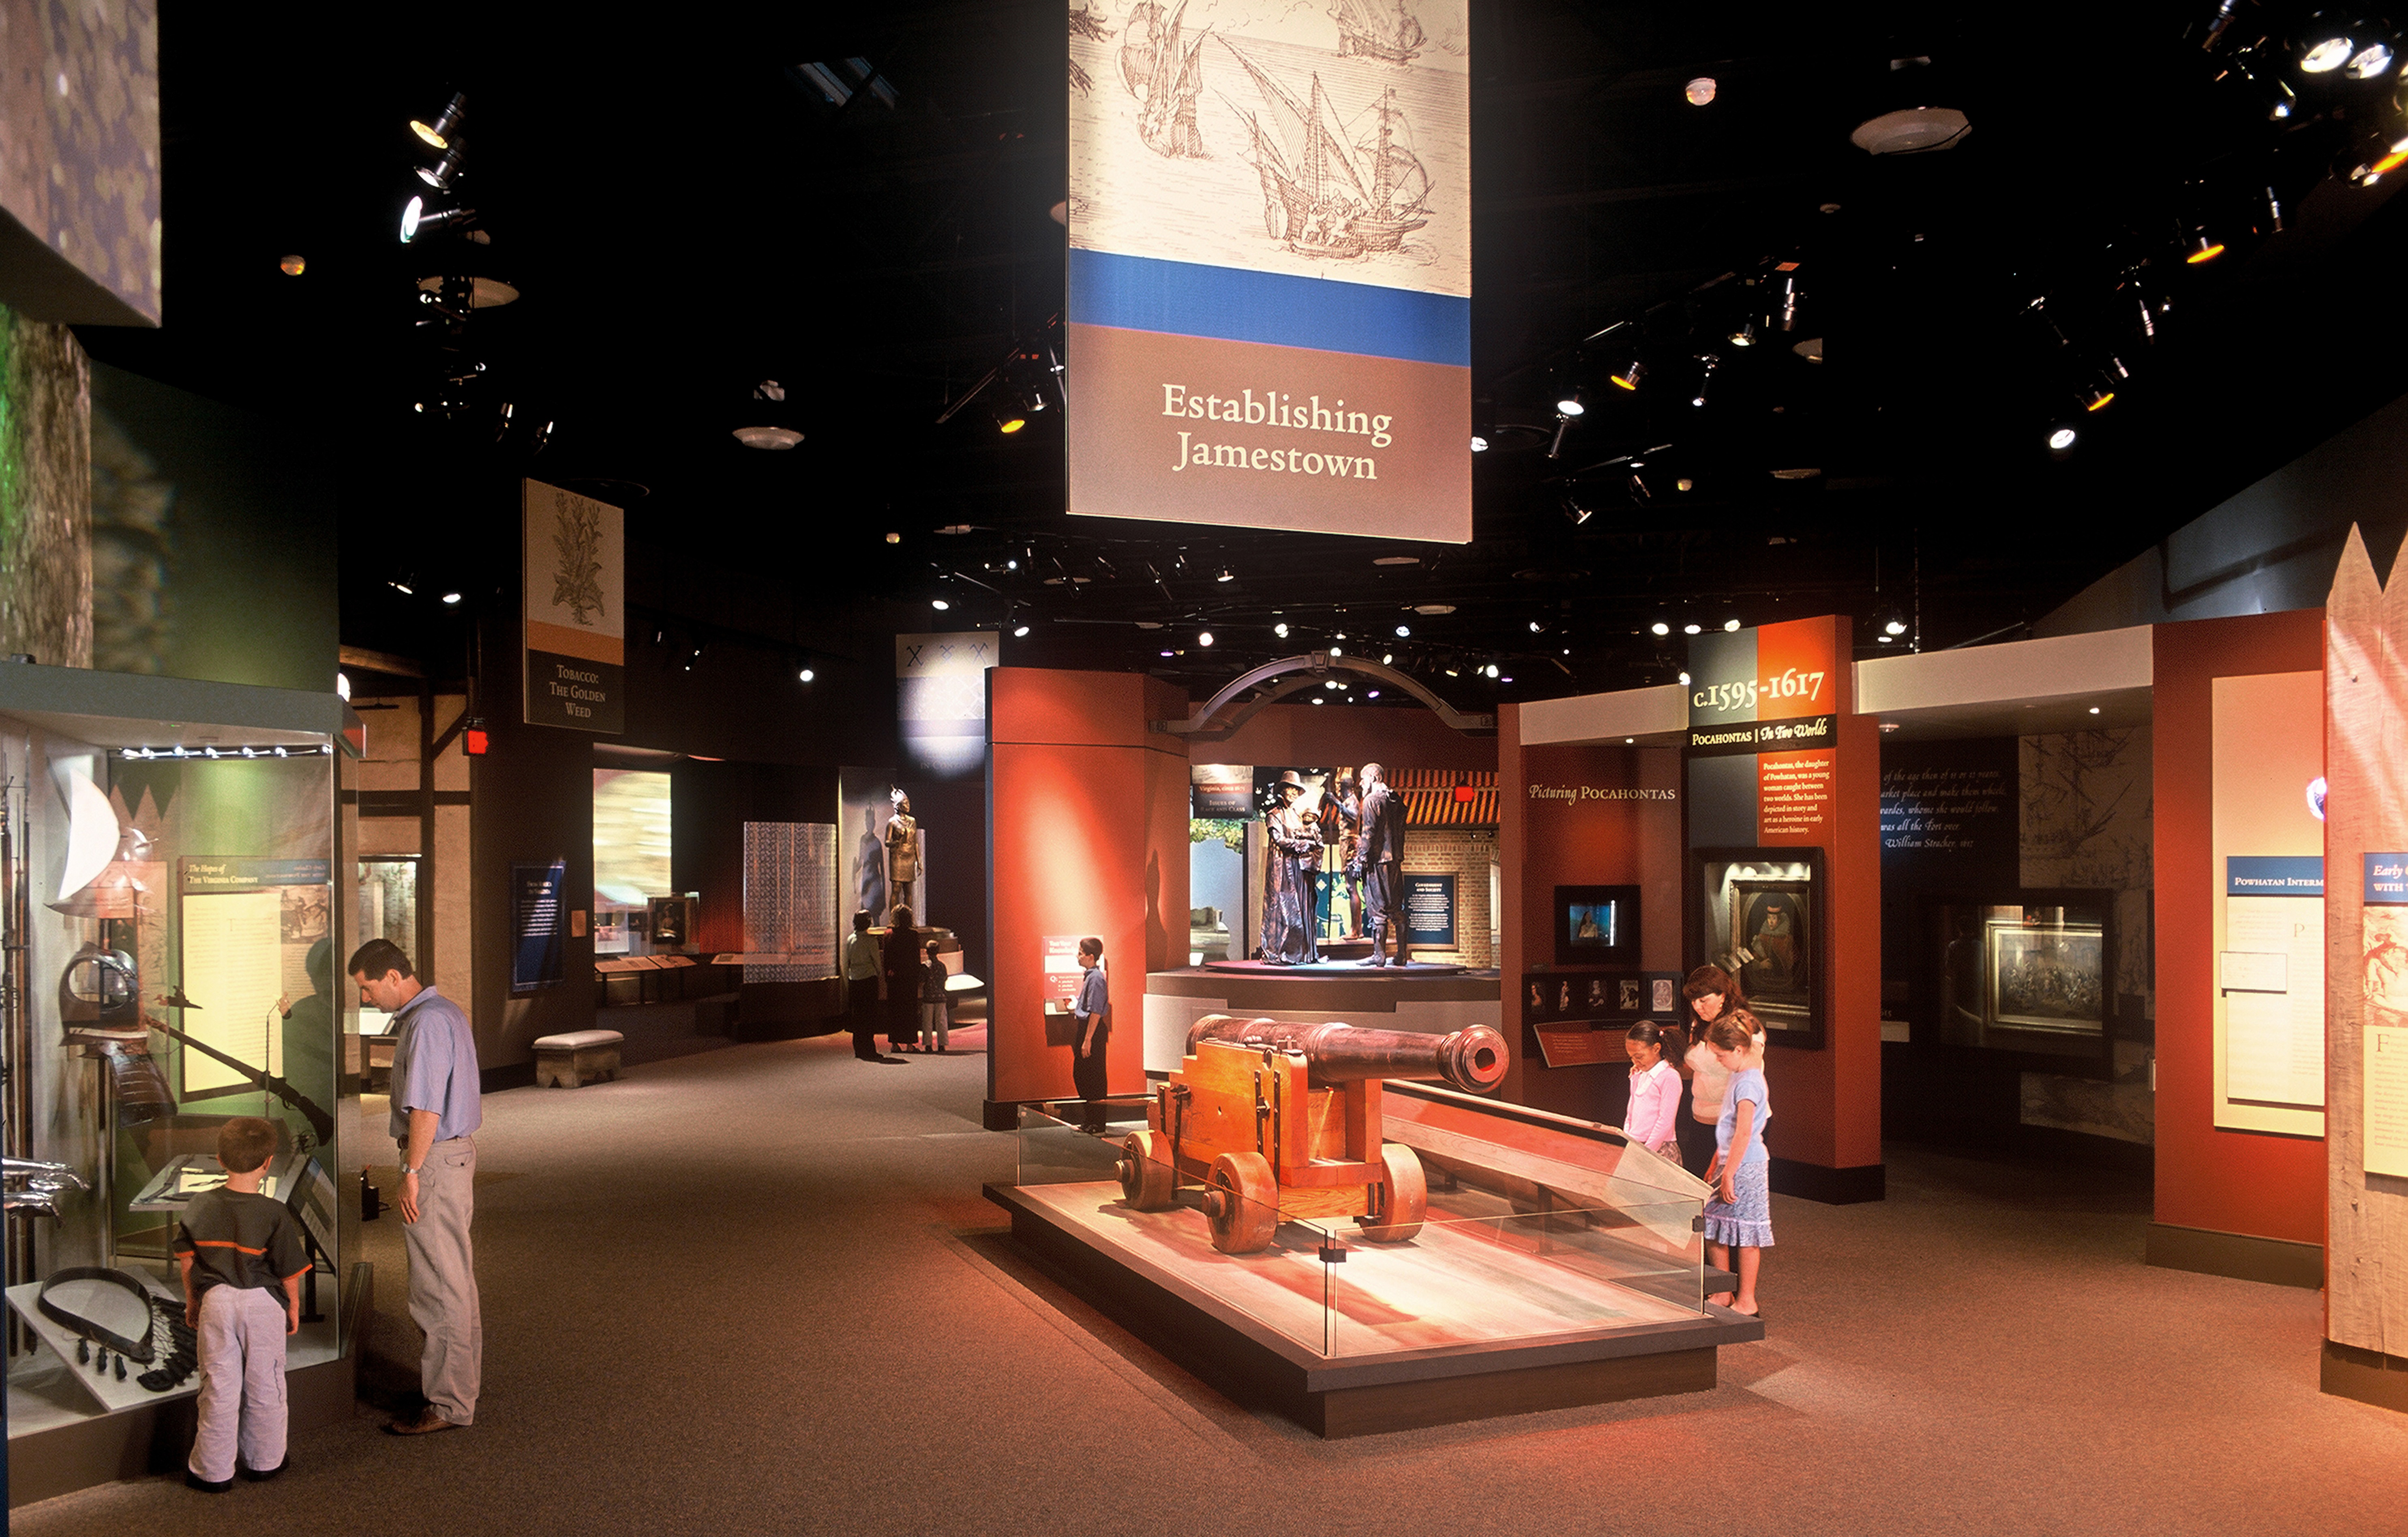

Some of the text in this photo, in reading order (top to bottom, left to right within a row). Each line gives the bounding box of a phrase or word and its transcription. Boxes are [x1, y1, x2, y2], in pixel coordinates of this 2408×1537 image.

[1162, 384, 1392, 447] Establishing
[1172, 431, 1378, 480] Jamestown
[556, 665, 599, 684] TOBACCO:
[549, 681, 606, 702] THE GOLDEN
[566, 702, 591, 718] WEED
[1692, 717, 1827, 746] POCAHONTAS In Two Worlds
[1763, 759, 1829, 770] Pocahontas, the daughter
[1812, 772, 1830, 780] young
[1783, 782, 1801, 792] caught
[1529, 784, 1676, 806] Picturing POCAHONTAS
[1763, 804, 1786, 814] depicted
[1810, 815, 1823, 823] early
[1897, 819, 1911, 831] all
[1911, 818, 1922, 831] the
[1789, 825, 1809, 834] history.
[1885, 834, 1922, 848] William
[189, 864, 200, 872] The
[218, 864, 227, 875] of
[2373, 864, 2403, 879] Early
[2235, 877, 2285, 886] POWHATAN
[2373, 883, 2404, 892] WITH
